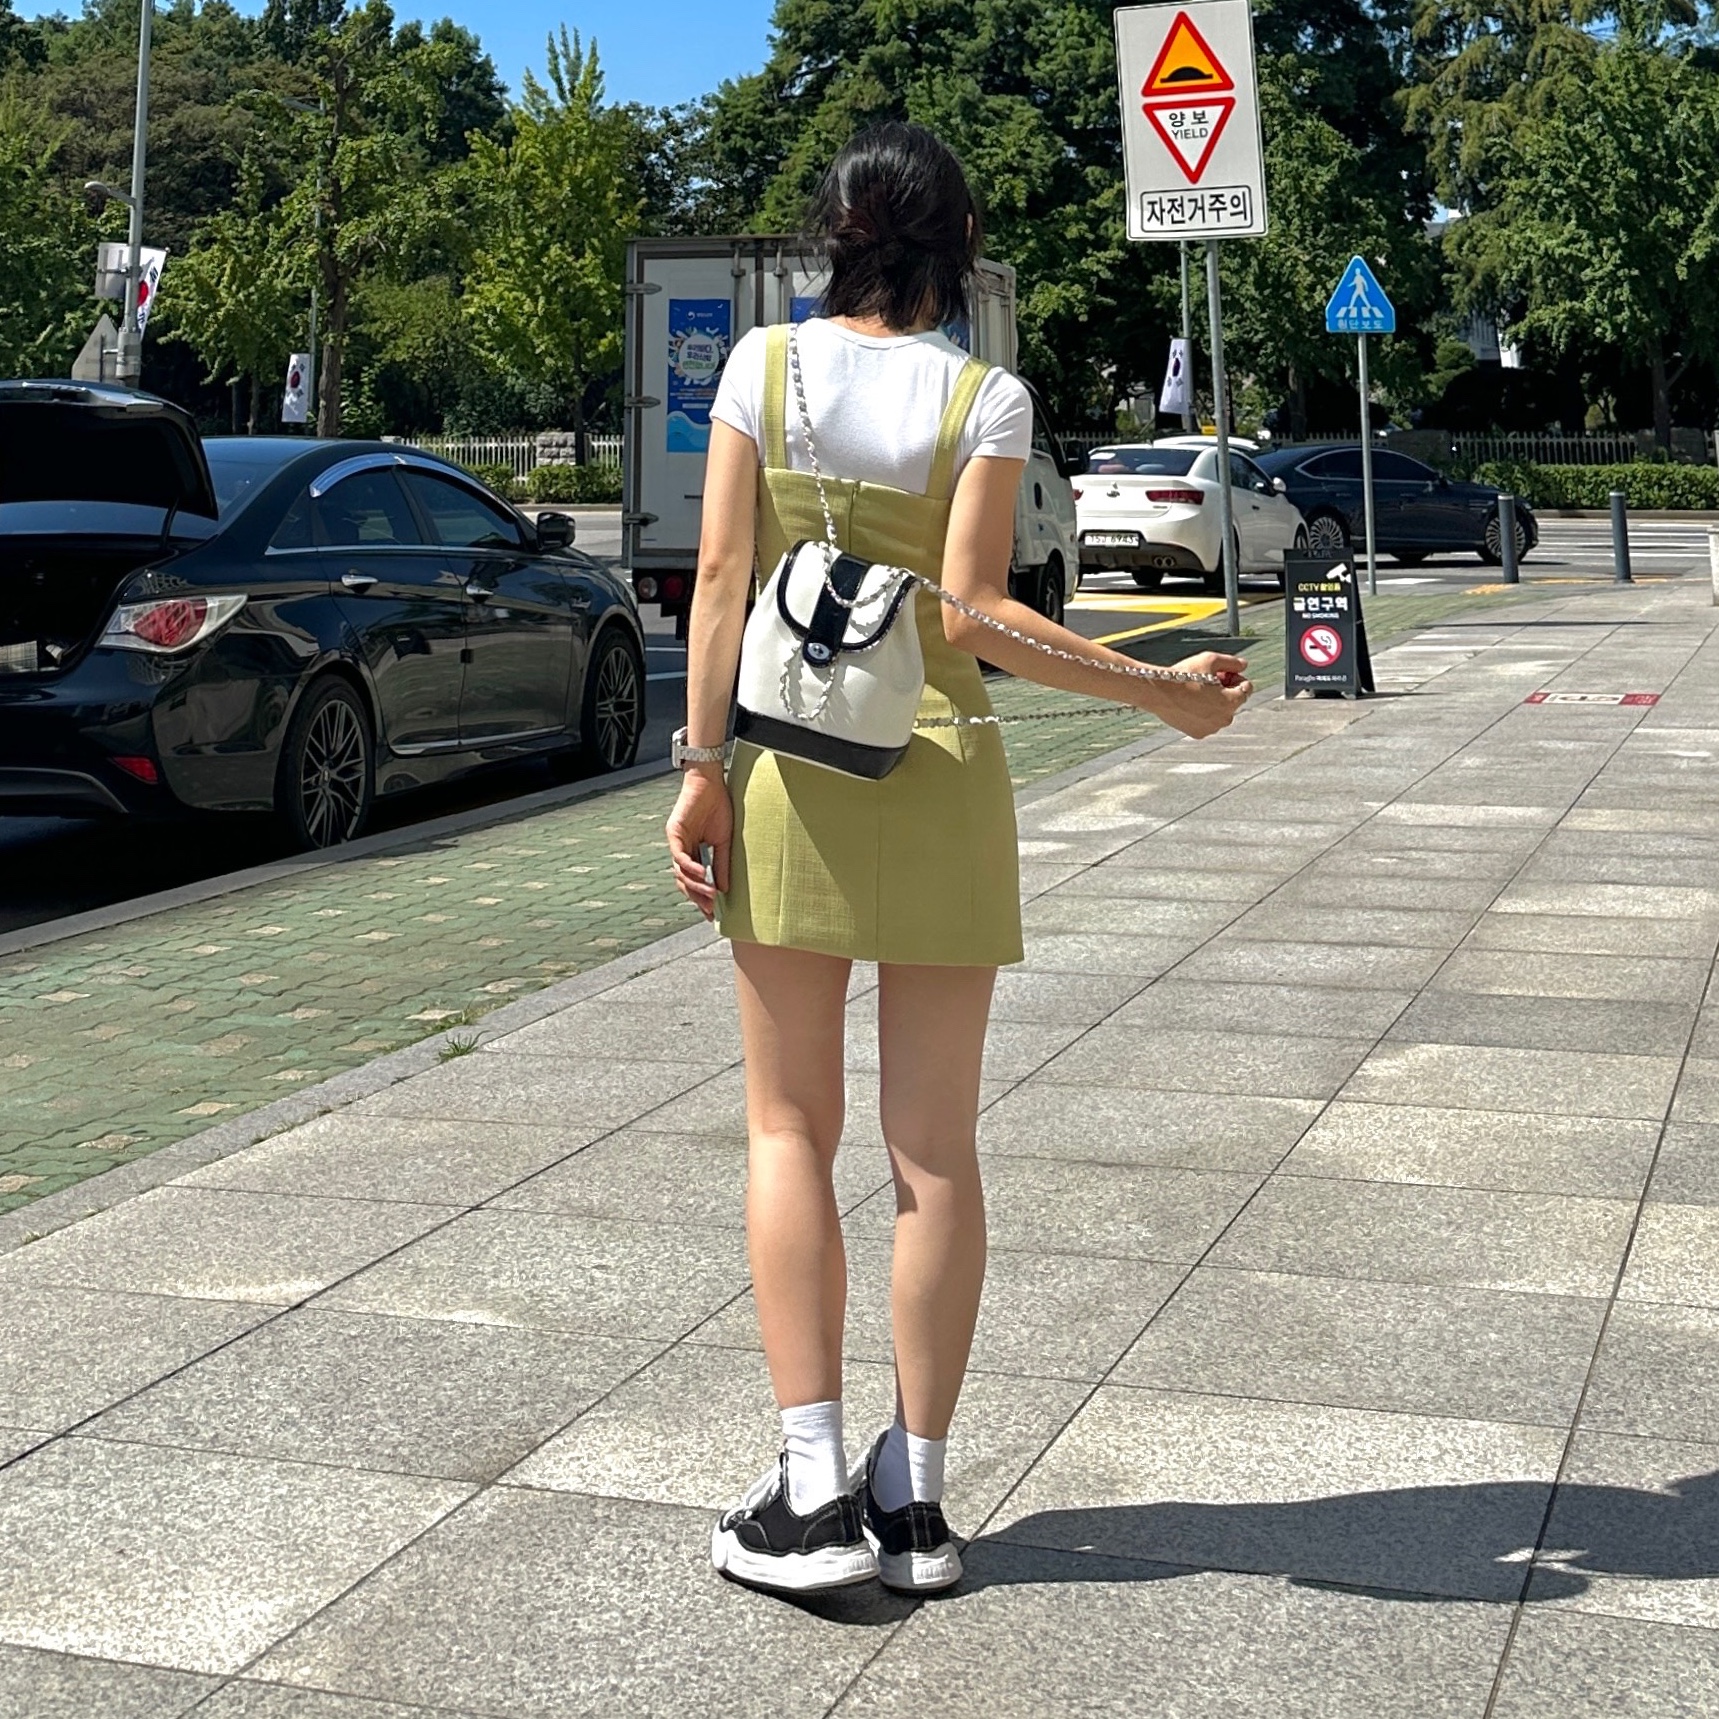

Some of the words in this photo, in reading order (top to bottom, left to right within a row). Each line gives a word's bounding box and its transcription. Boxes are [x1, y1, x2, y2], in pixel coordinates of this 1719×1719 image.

[1168, 110, 1209, 127] 양보
[1171, 127, 1209, 140] YIELD
[1146, 191, 1248, 226] 자전거주의
[1298, 582, 1320, 592] CCTV
[1293, 596, 1348, 611] 금연구역
